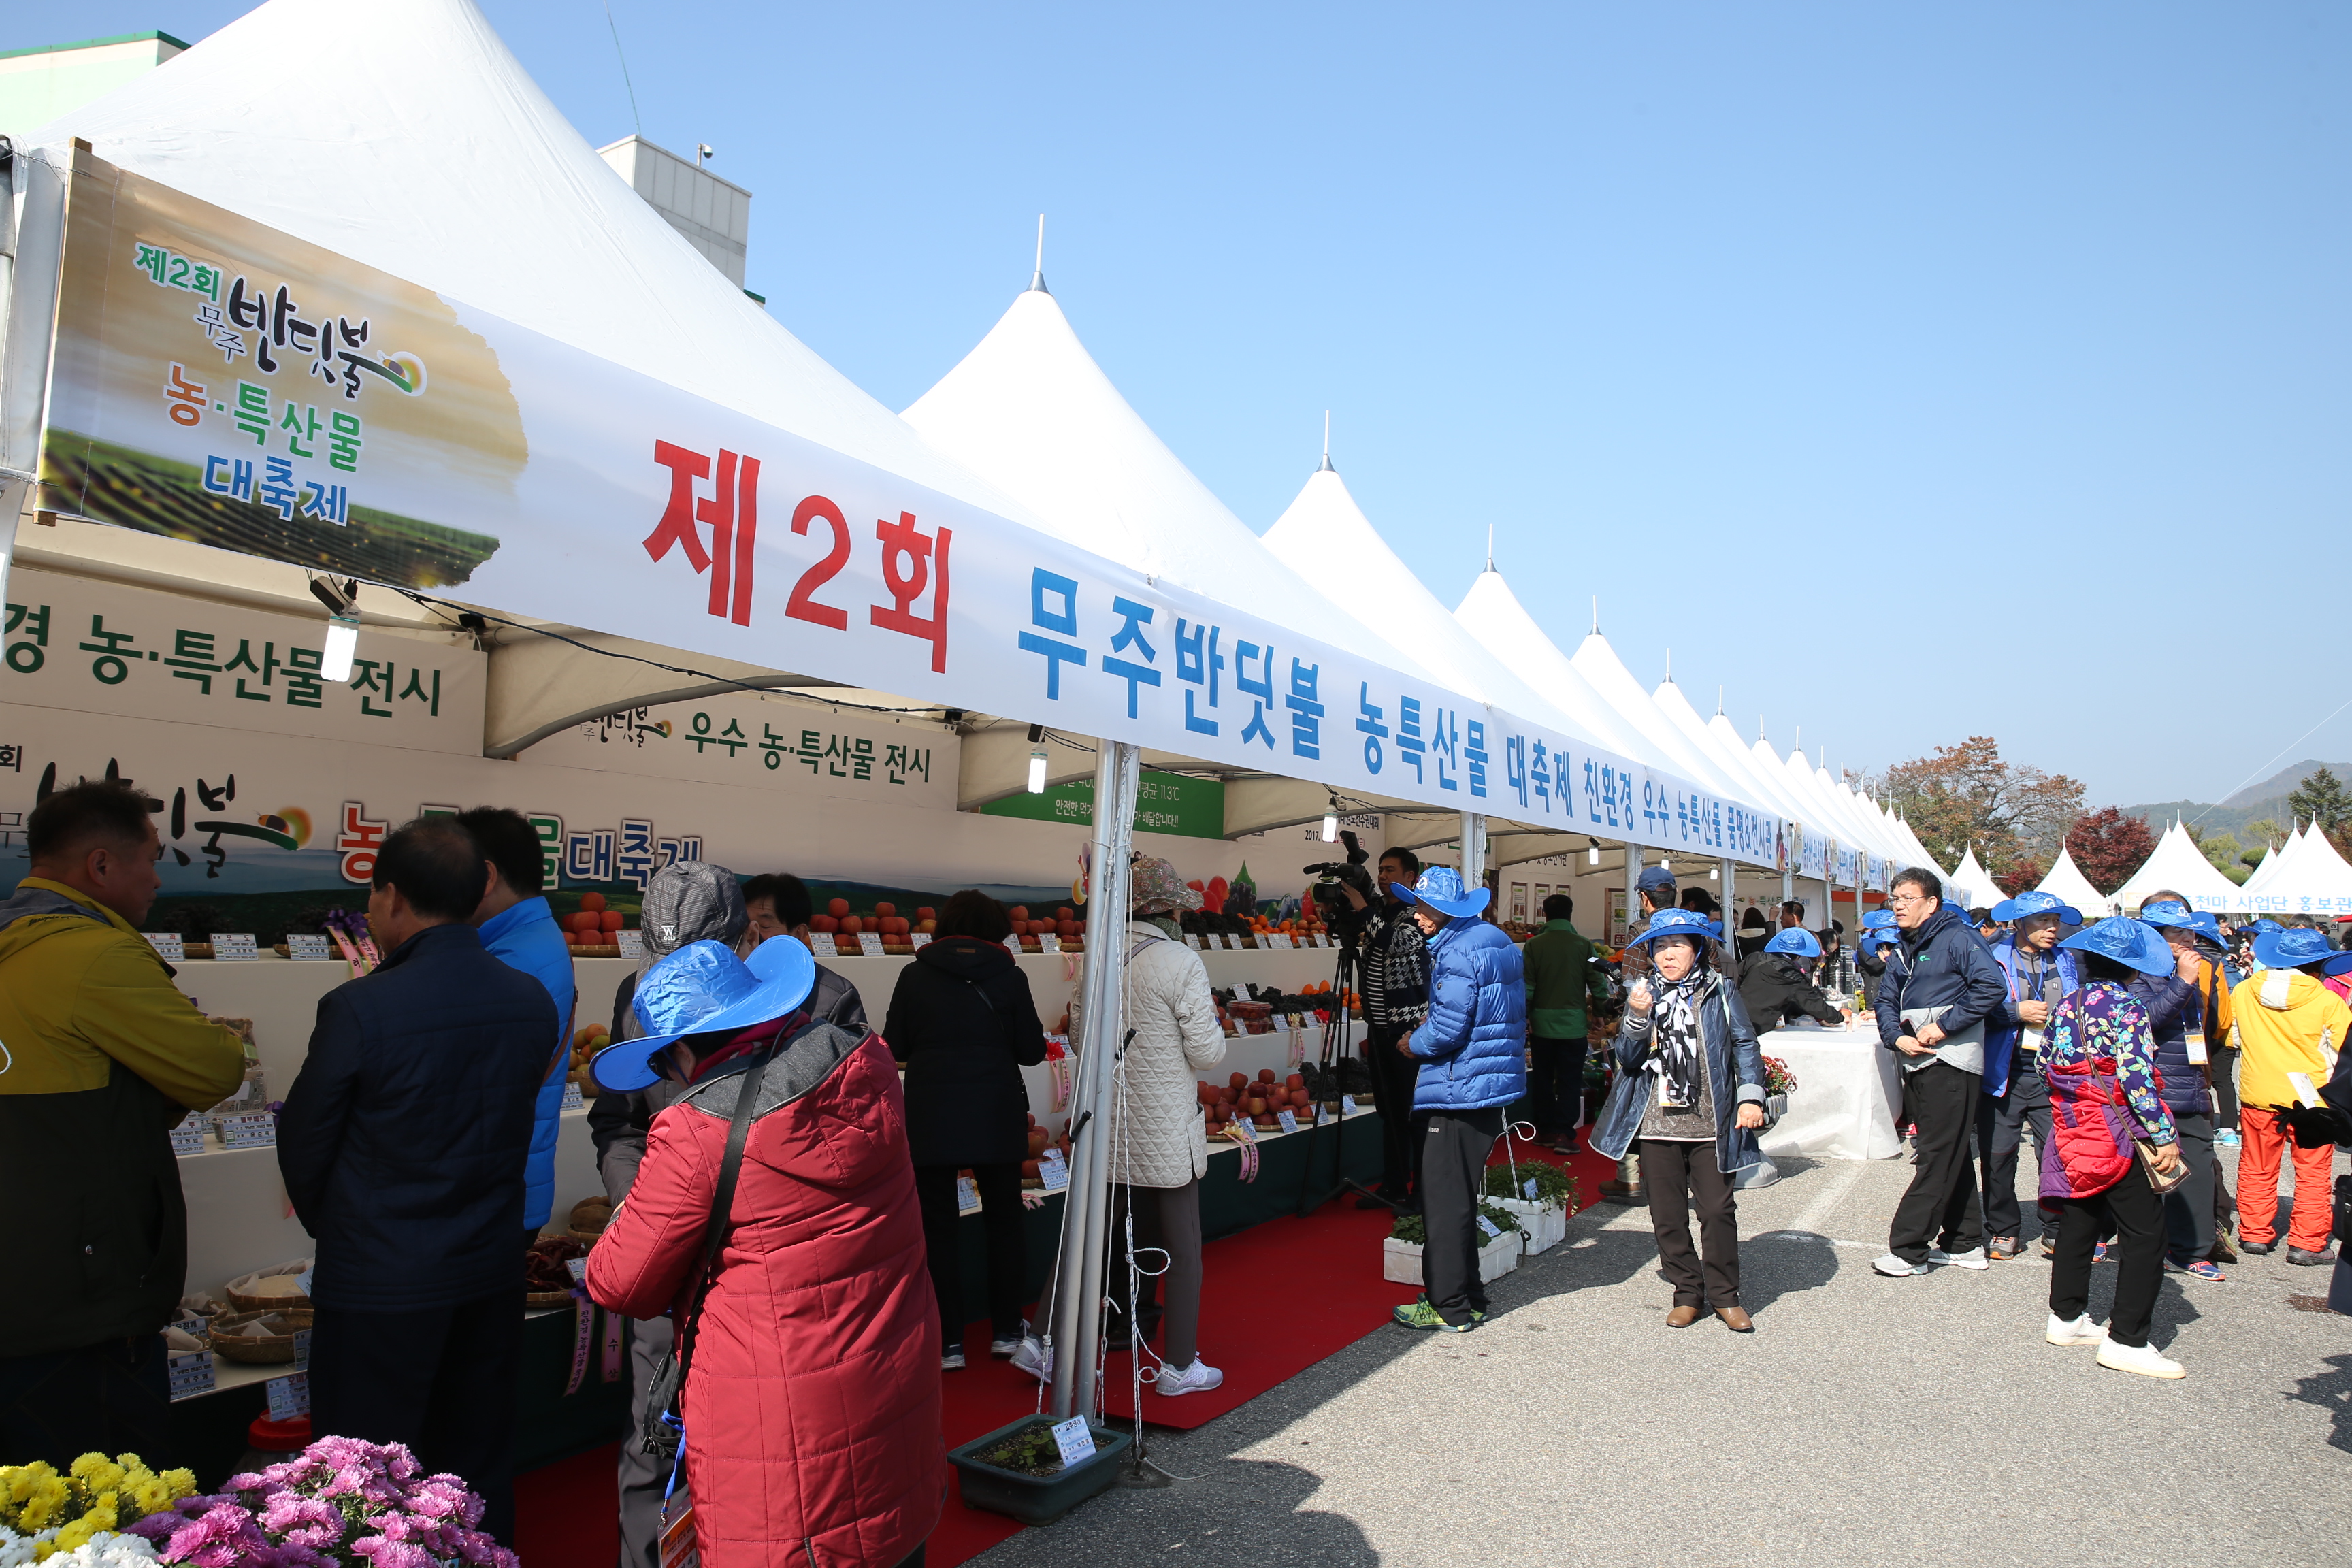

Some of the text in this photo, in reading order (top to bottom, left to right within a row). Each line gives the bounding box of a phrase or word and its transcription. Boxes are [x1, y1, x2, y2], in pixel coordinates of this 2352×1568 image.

[136, 242, 220, 301] 제2회
[197, 276, 414, 399] 무주 반딧불
[163, 362, 364, 472] 농·특산물
[203, 454, 348, 526] 대축제
[642, 439, 952, 674] 제2회
[1018, 566, 1325, 761] 무주반딧불
[1355, 681, 1489, 798] 농특산물
[1506, 734, 1573, 818] 대축제
[1584, 757, 1634, 831] 친환경
[1643, 779, 1669, 838] 우수
[1678, 790, 1722, 847] 농특산물
[350, 658, 442, 718] 전시
[685, 712, 749, 760] 우수
[885, 743, 931, 783] 전시
[1056, 799, 1078, 817] 안전한
[1142, 811, 1179, 828] 배달합니다!!
[2236, 896, 2288, 911] 사업단
[2296, 896, 2352, 912] 홍보관
